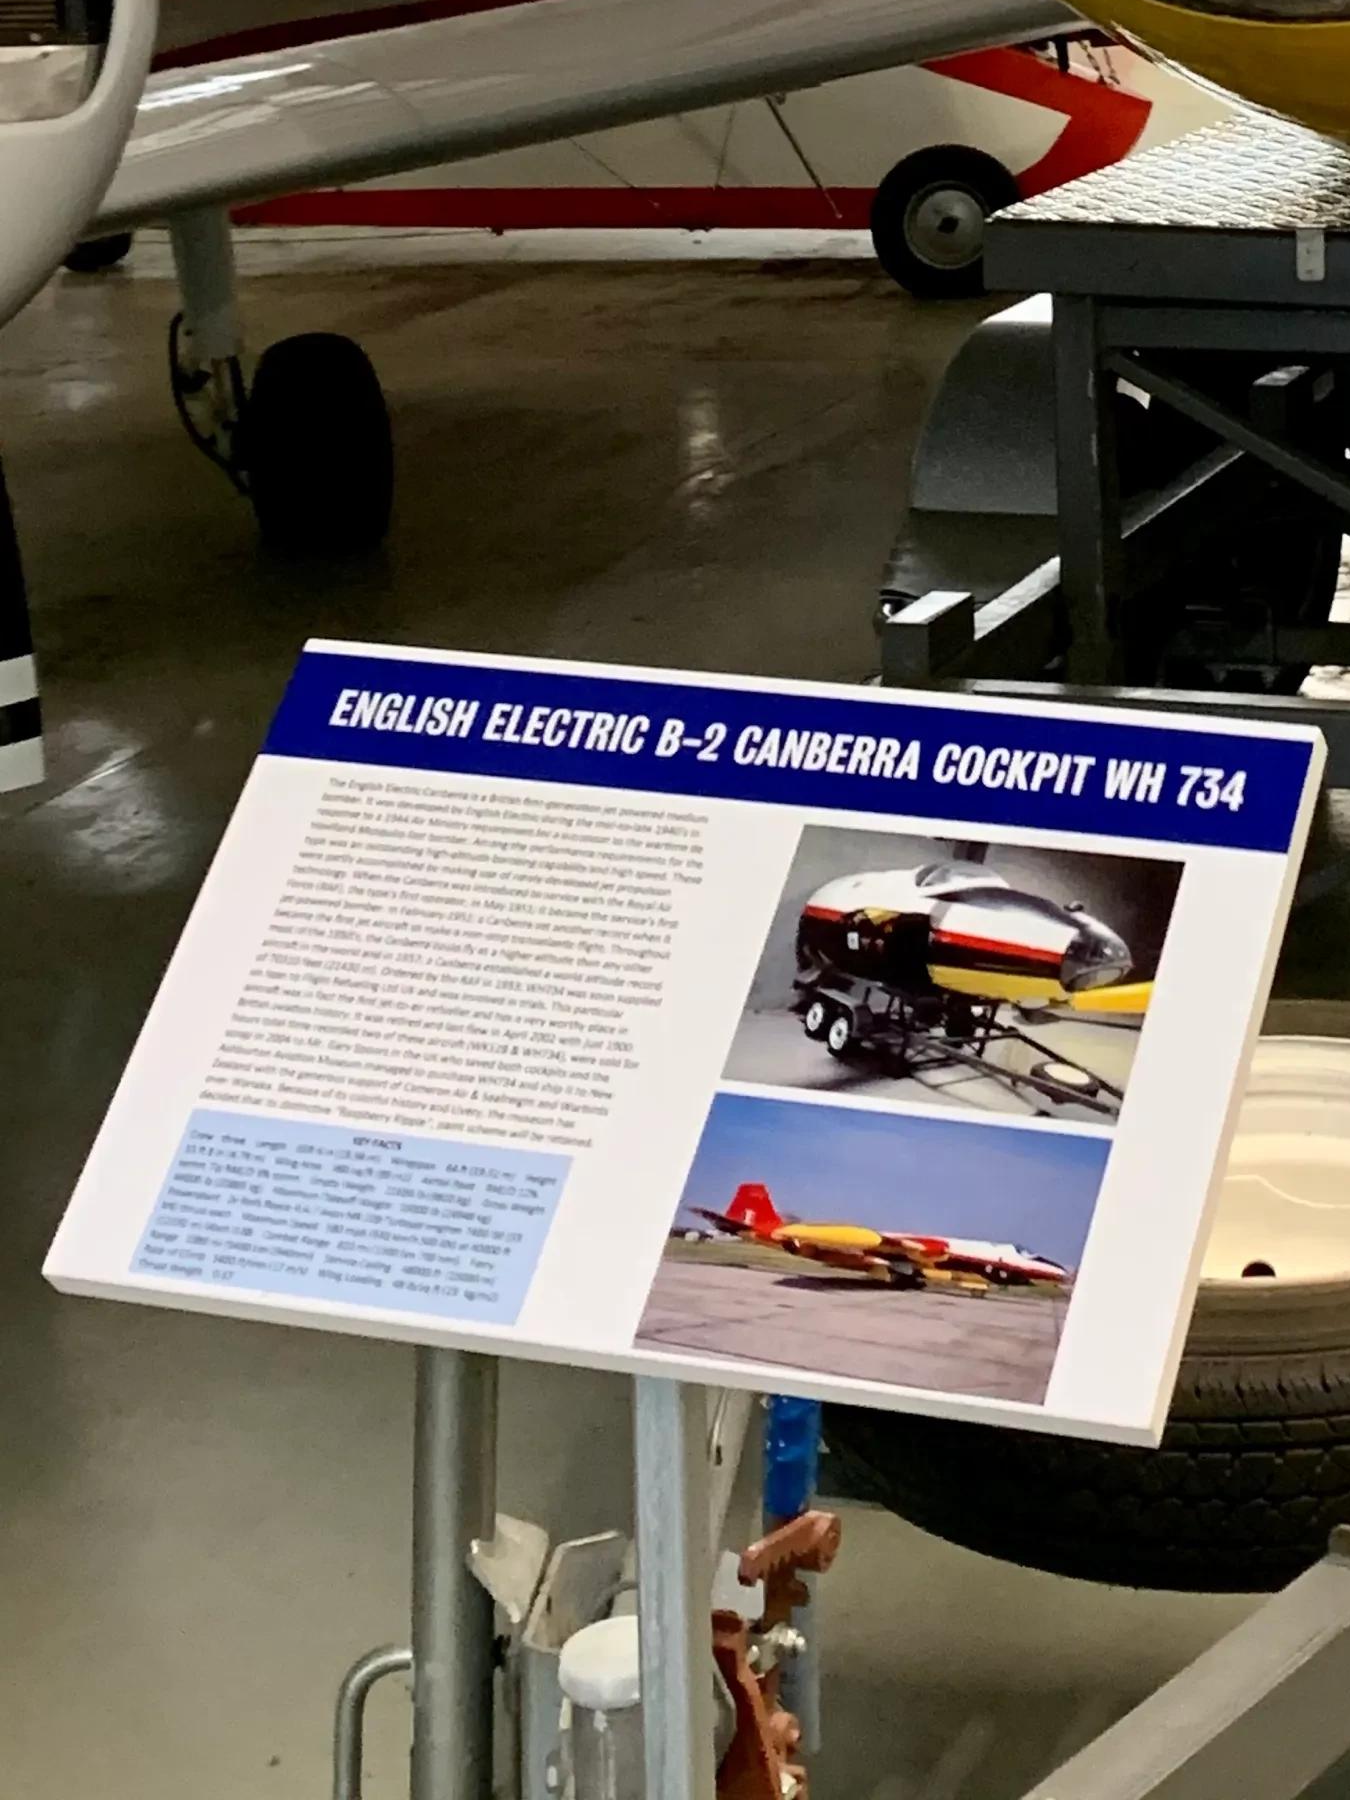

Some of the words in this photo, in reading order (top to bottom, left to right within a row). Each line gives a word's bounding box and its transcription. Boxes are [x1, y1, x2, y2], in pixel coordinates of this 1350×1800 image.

[329, 688, 480, 738] ENGLISH
[482, 702, 651, 755] ELECTRIC
[653, 718, 727, 763] B-2
[732, 725, 921, 781] CANBERRA
[931, 742, 1097, 796] COCKPIT
[1104, 758, 1167, 804] WH
[1176, 765, 1247, 812] 734
